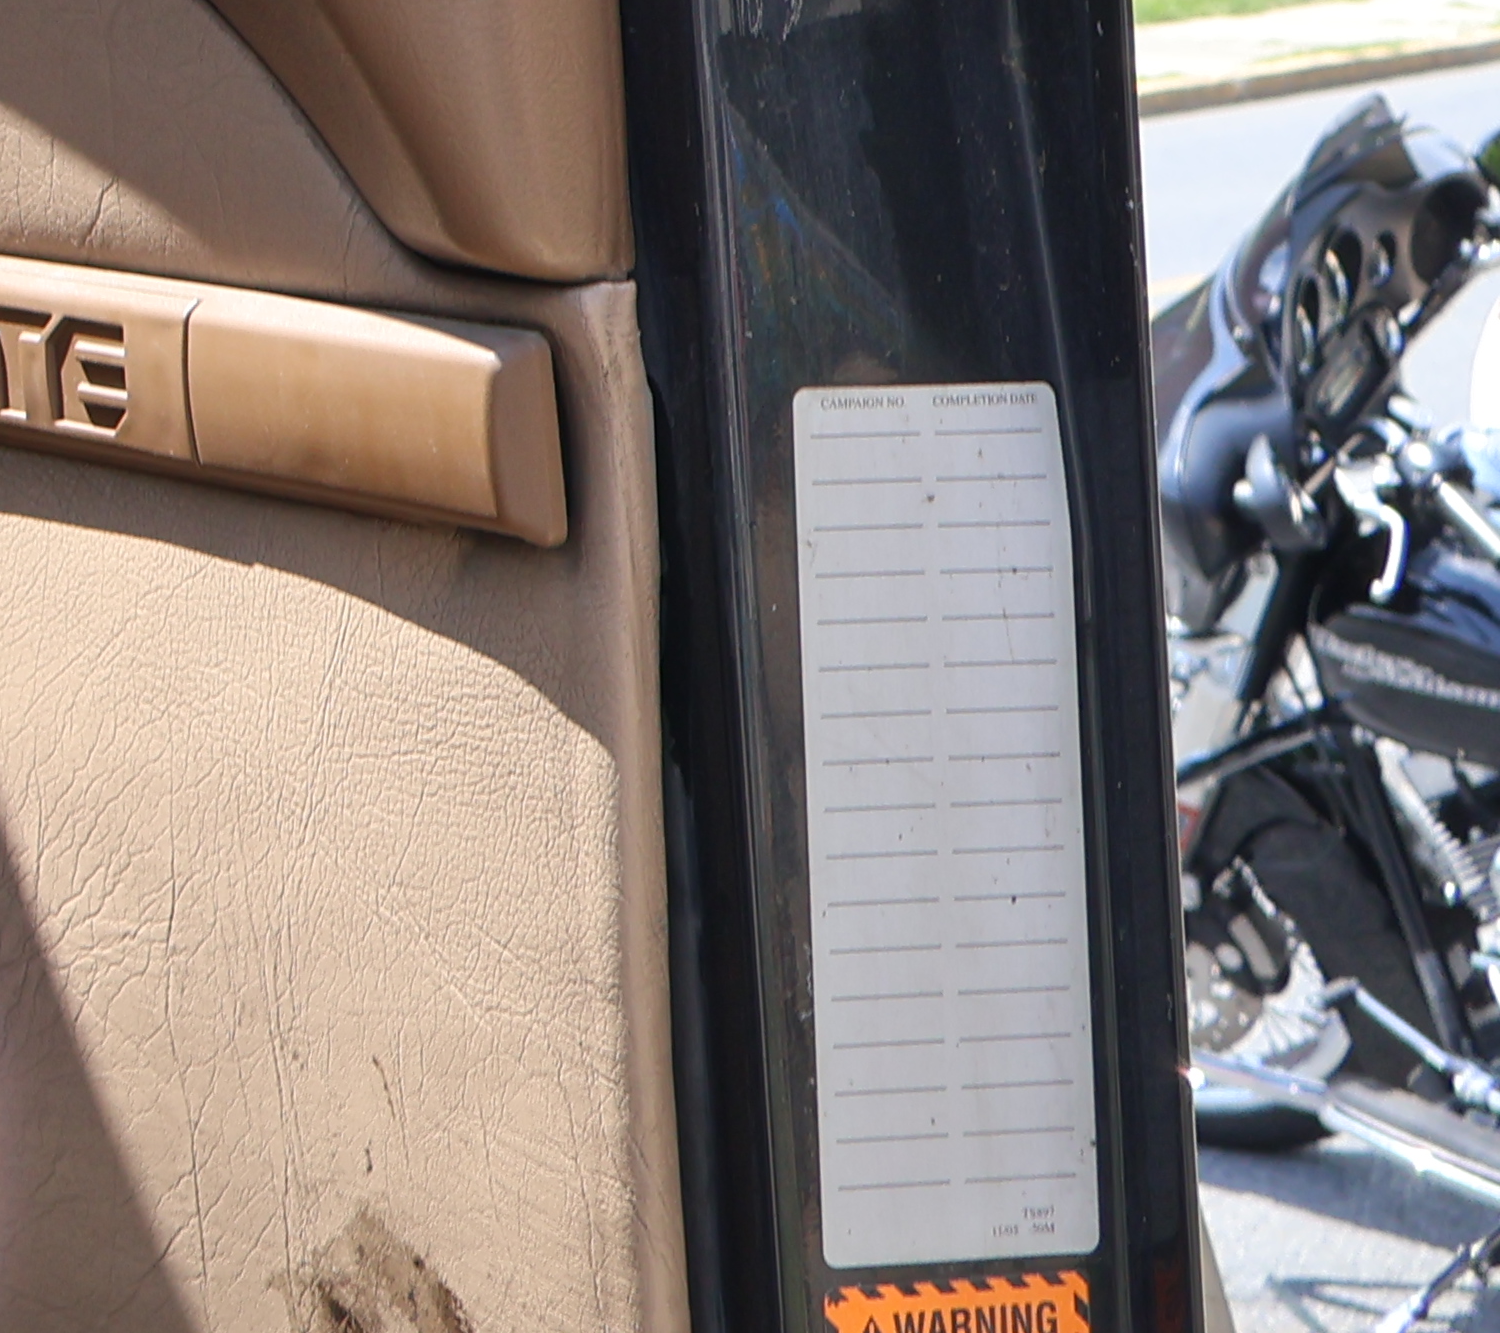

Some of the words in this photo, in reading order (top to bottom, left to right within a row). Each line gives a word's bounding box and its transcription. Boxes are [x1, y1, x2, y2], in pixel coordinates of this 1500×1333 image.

[820, 396, 884, 411] CAMPAIGN
[932, 393, 1008, 408] COMPLETION
[1009, 392, 1037, 405] DATE
[893, 1300, 1059, 1333] WARNING
